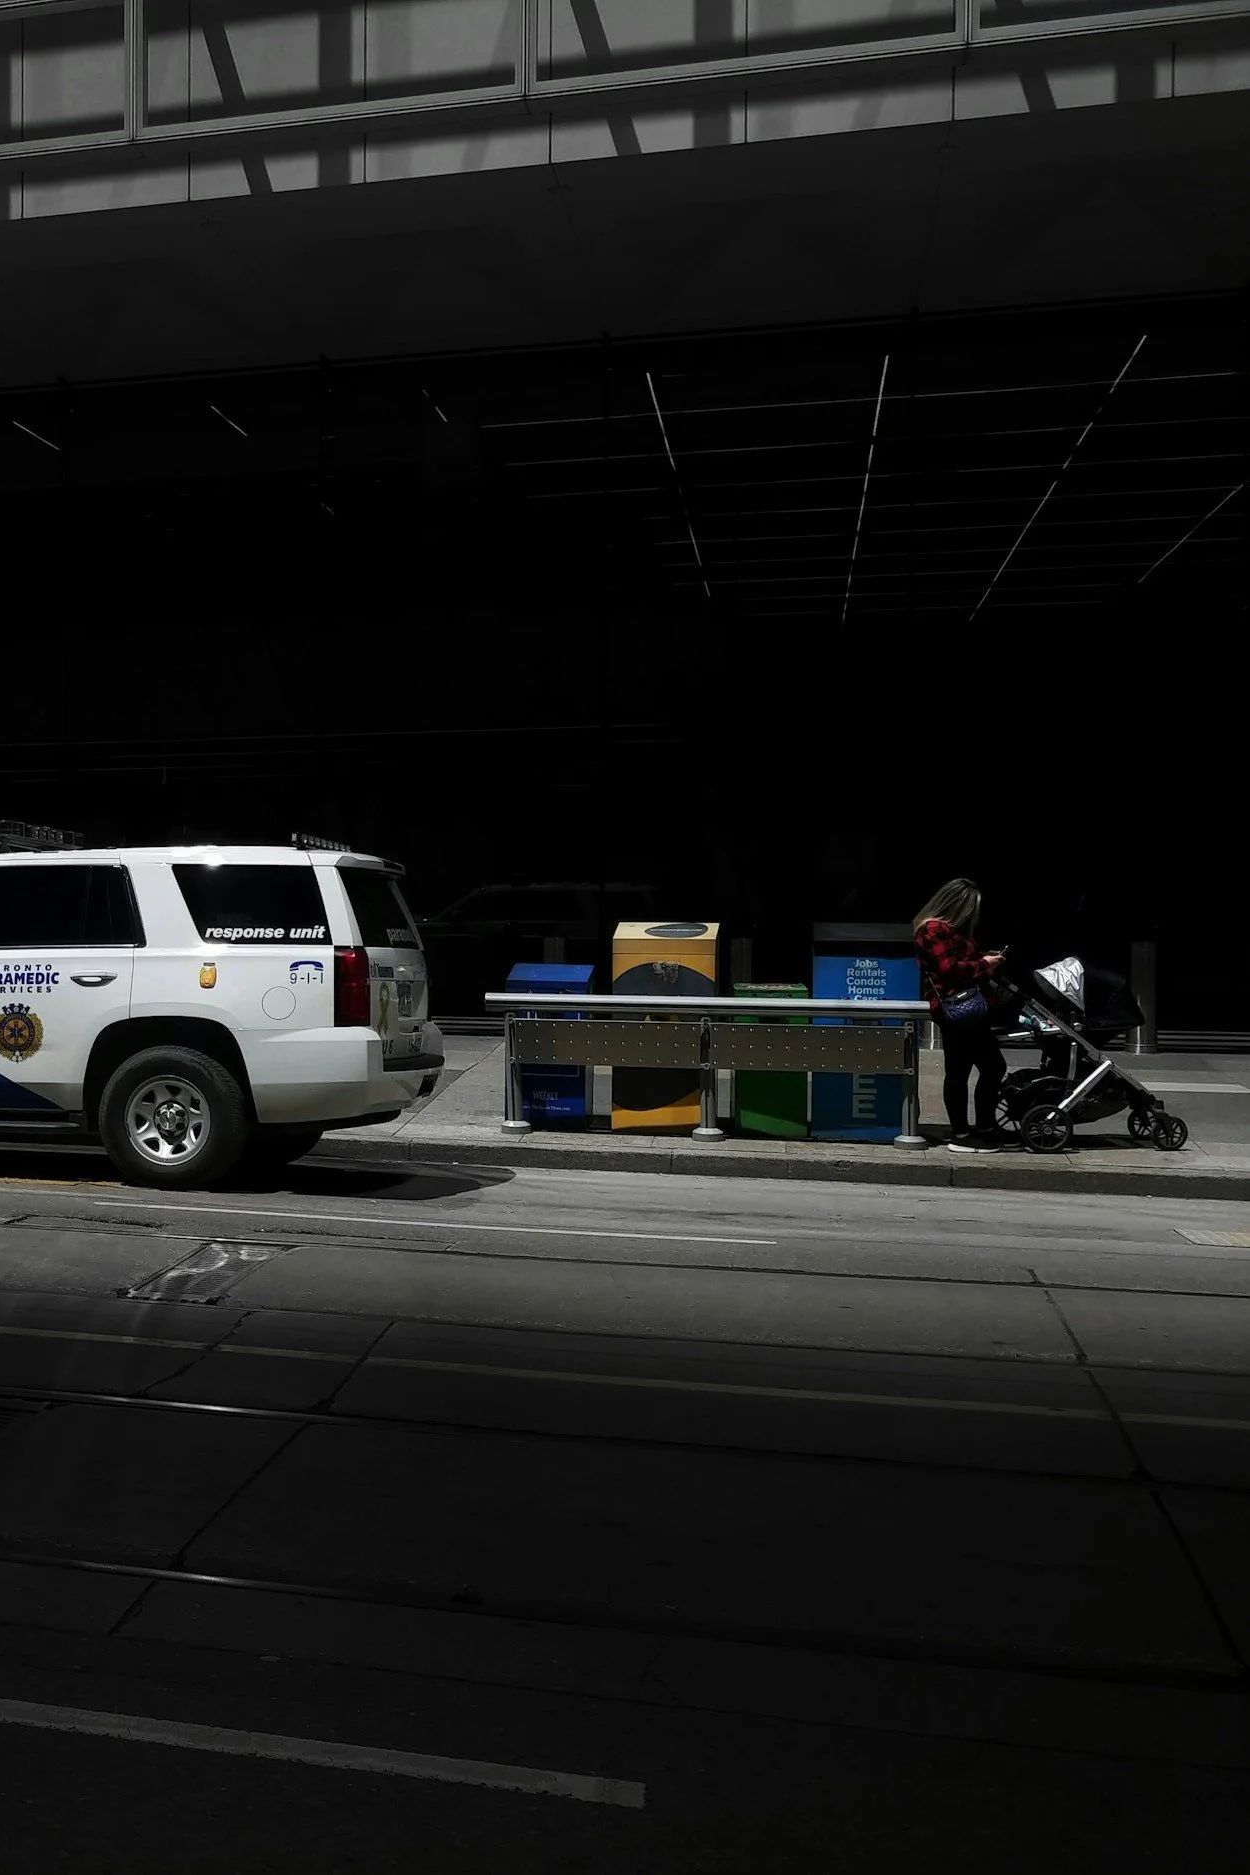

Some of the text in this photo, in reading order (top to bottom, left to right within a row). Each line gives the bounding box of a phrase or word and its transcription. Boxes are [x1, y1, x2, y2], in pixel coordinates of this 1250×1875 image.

[205, 925, 326, 941] response unit
[854, 959, 879, 968] Jobs
[846, 968, 887, 977] Rentals
[846, 976, 887, 986] Condos
[847, 985, 886, 995] Homes
